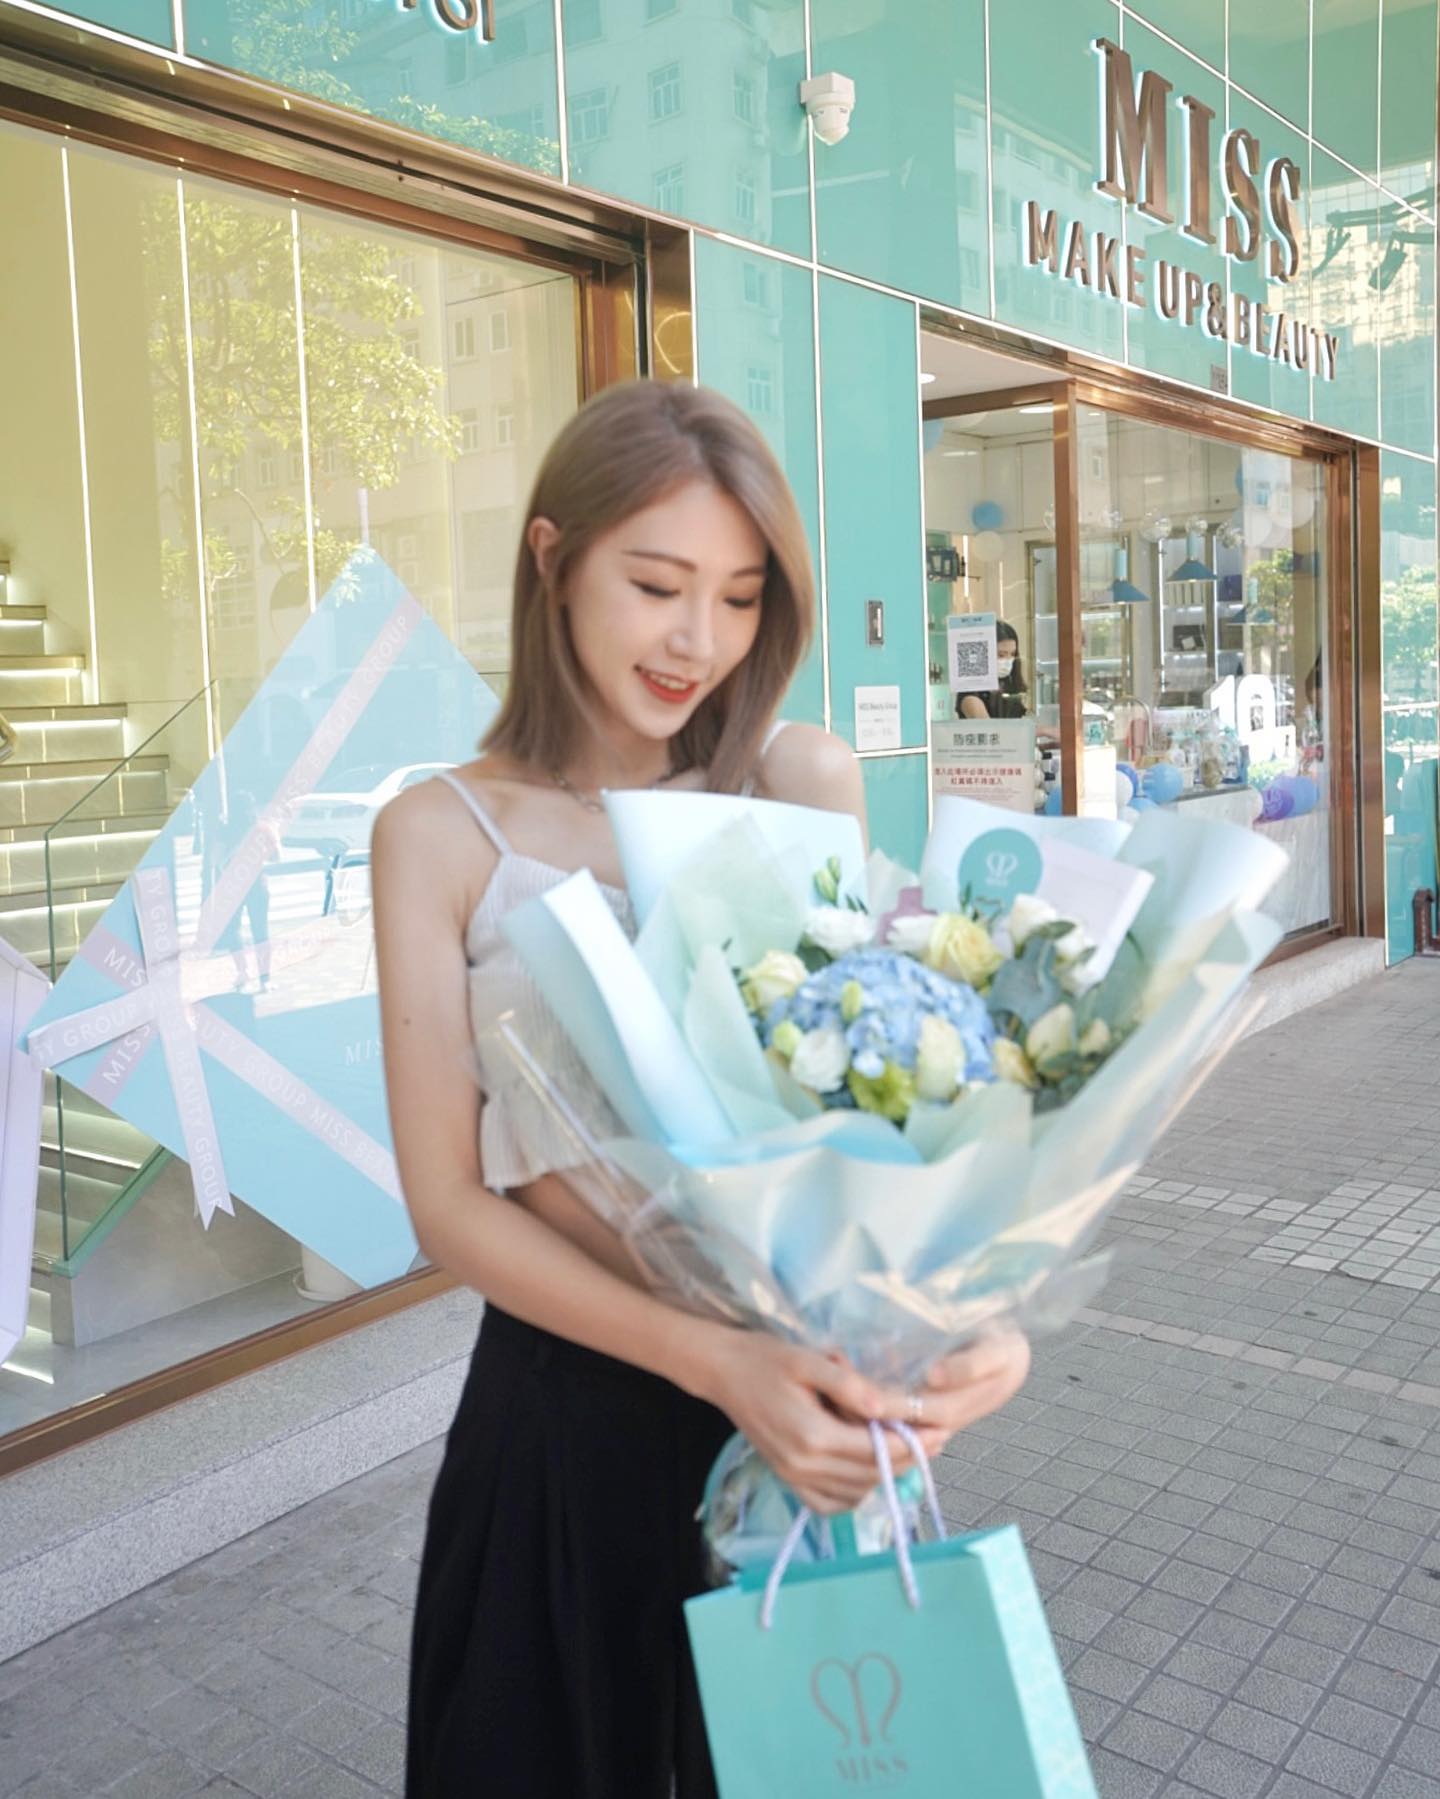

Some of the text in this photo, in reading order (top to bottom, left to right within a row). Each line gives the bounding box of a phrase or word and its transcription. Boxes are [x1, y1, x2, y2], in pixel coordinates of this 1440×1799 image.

[1091, 37, 1300, 284] MISS
[1022, 200, 1147, 309] MAKE
[363, 614, 407, 684] GROUP
[244, 1055, 307, 1107] GROUP
[310, 1104, 353, 1146] MISS
